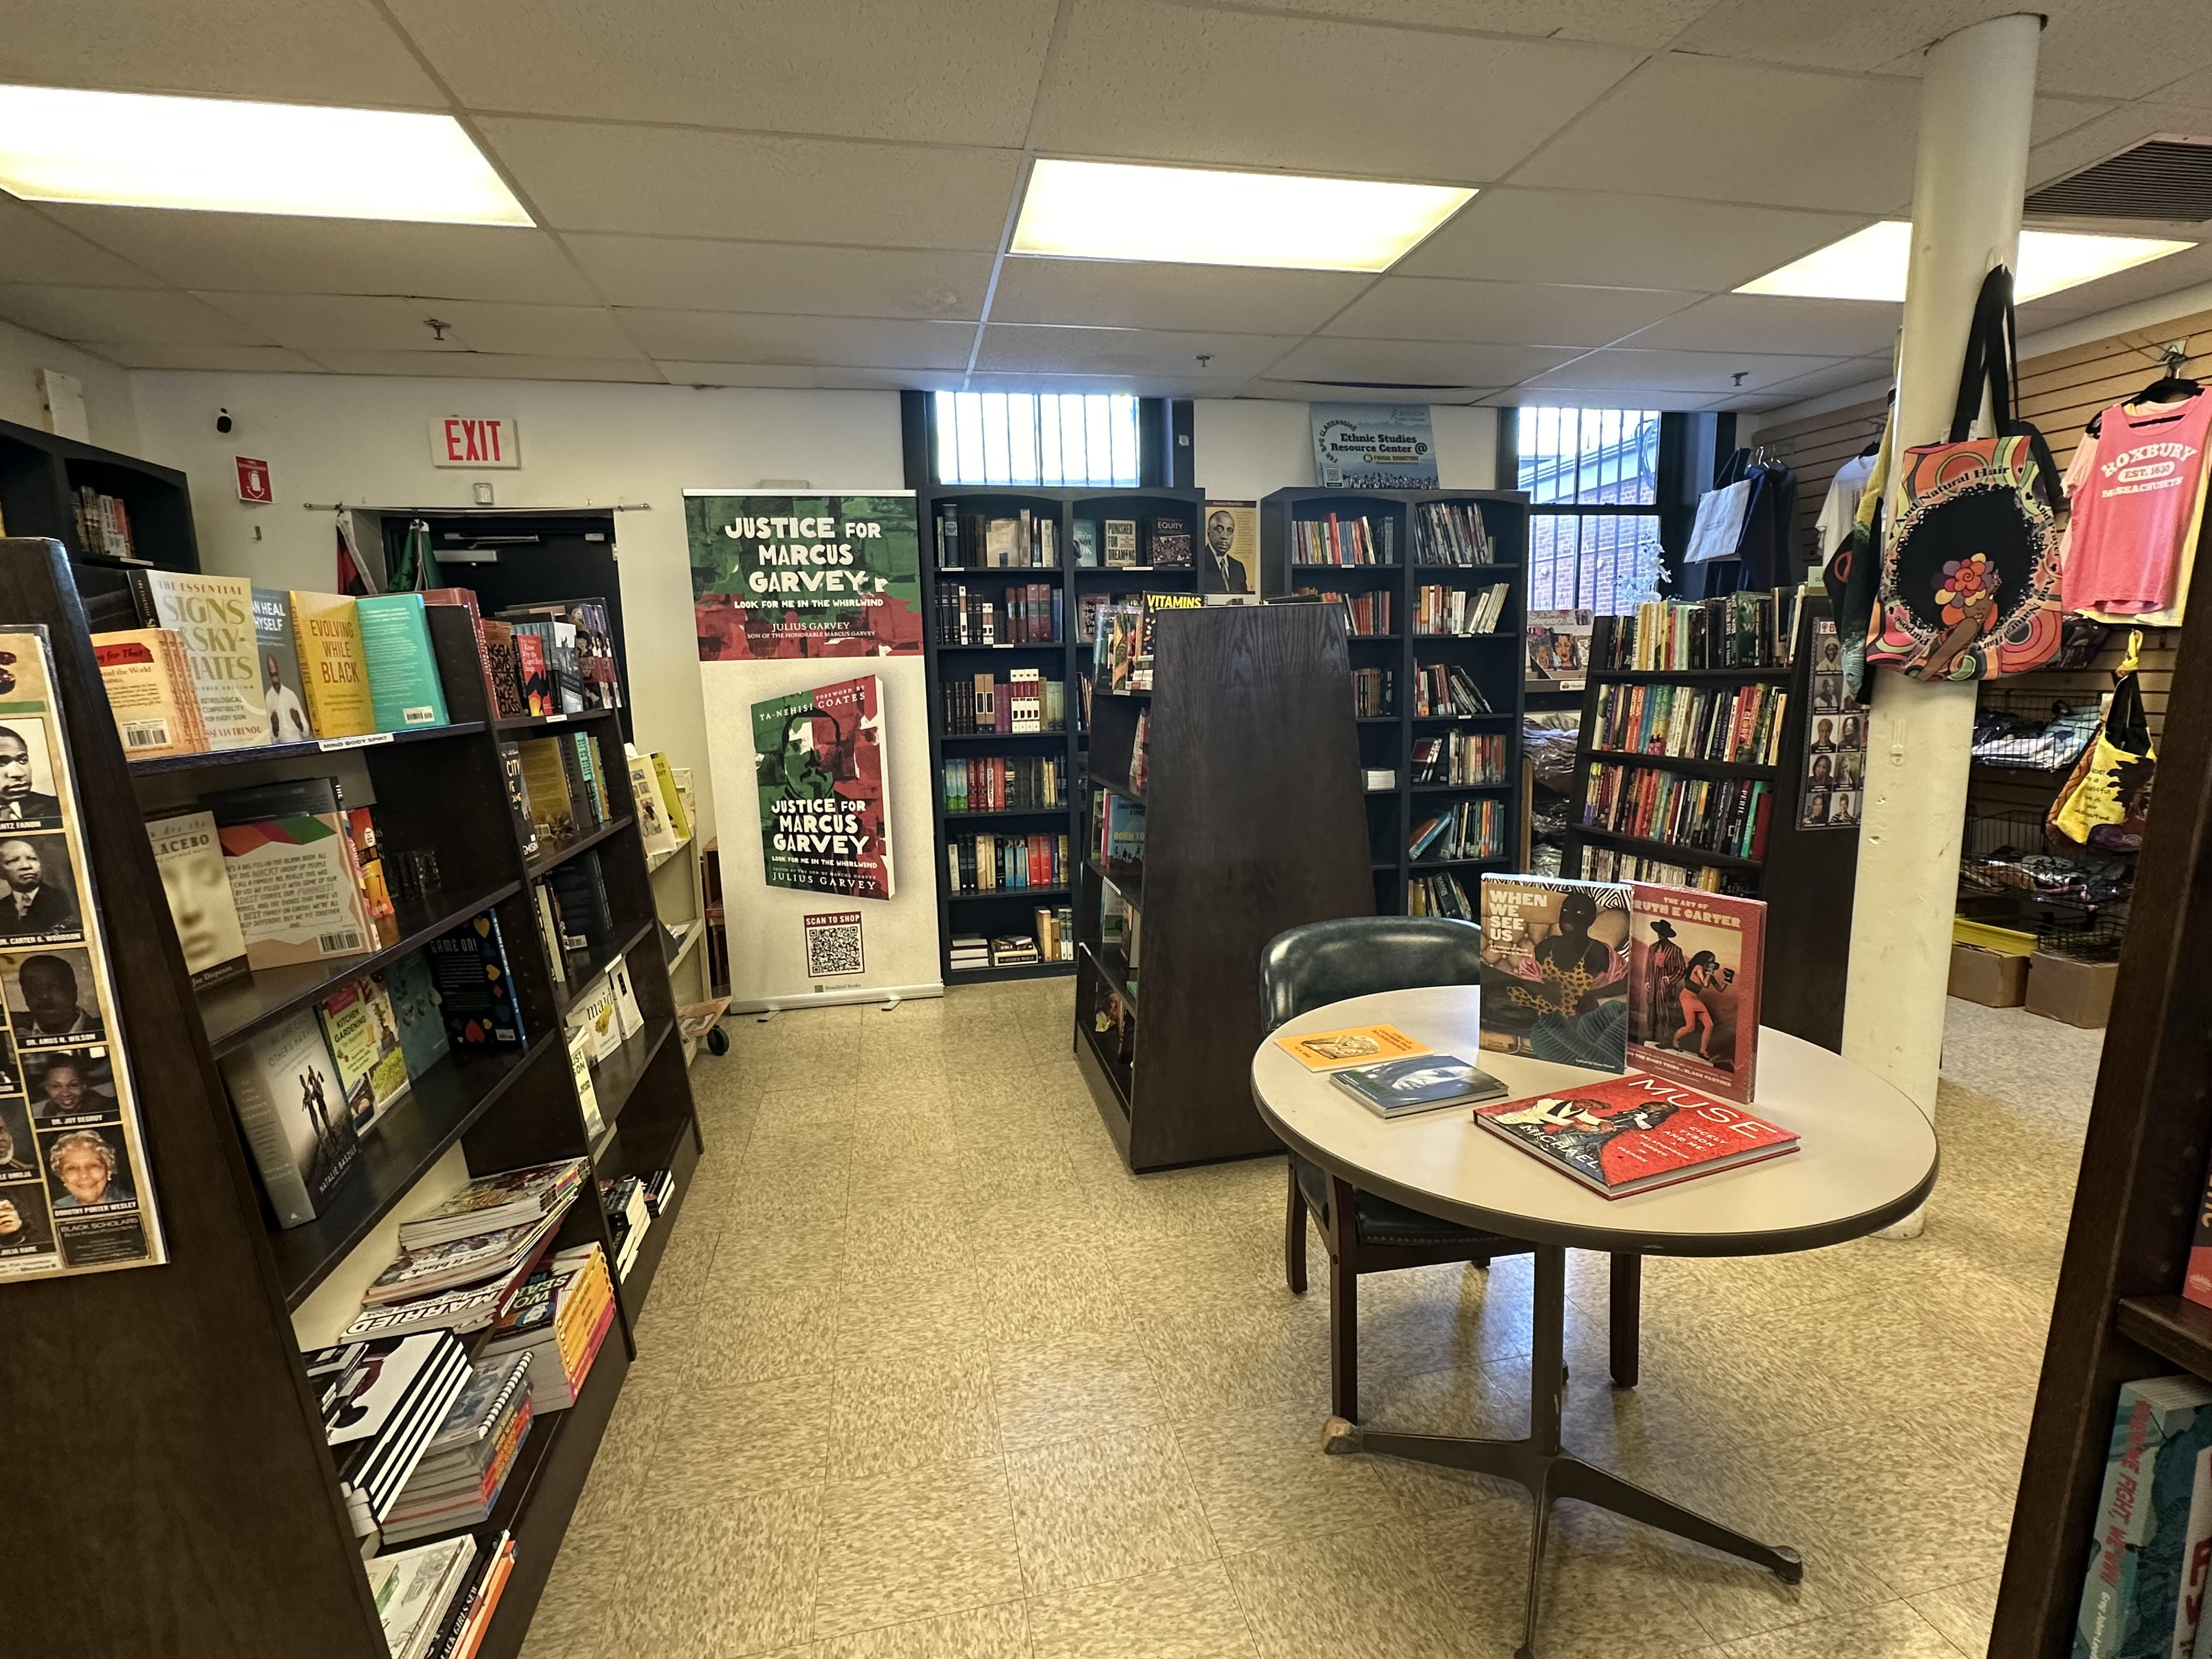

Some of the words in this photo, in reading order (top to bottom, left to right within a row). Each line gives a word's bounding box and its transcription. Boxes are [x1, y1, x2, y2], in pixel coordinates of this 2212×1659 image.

[444, 420, 501, 461] EXIT
[1340, 433, 1375, 443] Ethnic
[1378, 435, 1417, 443] Studies
[1331, 443, 1377, 453] Resource
[1379, 444, 1412, 453] Center
[1415, 442, 1427, 455] @
[2101, 442, 2199, 478] ROXBURY
[2124, 469, 2149, 478] EST.
[2151, 464, 2171, 475] 1630
[1895, 501, 1918, 528] And
[1920, 472, 1970, 507] Natural
[1974, 465, 2011, 481] Hair
[725, 517, 835, 539] JUSTICE
[845, 523, 881, 538] FOR
[1108, 523, 1133, 535] PUNISHED
[1158, 522, 1183, 531] EQUITY
[1108, 535, 1118, 548] FOR
[759, 544, 854, 566] MARCUS
[1108, 549, 1135, 561] DREAMING
[159, 580, 176, 590] THE
[180, 582, 242, 595] ESSENTIAL
[749, 571, 866, 592] GARVEY
[2036, 578, 2056, 602] And
[163, 595, 245, 624] SIGNS
[735, 600, 759, 609] LOOK
[762, 600, 778, 608] FOR
[781, 600, 794, 608] ME
[798, 600, 809, 608] IN
[811, 600, 830, 608] THE
[833, 599, 884, 607] WHIRLWIND
[1147, 595, 1201, 608] VITAMINS
[262, 603, 286, 617] HEAL
[255, 616, 284, 631] HYSELF
[310, 619, 354, 638] EVOLVING
[772, 623, 806, 633] JULIUS
[809, 622, 850, 630] GARVEY
[1894, 615, 1930, 646] Purpose
[198, 627, 246, 652] SKY-
[107, 650, 120, 659] for
[322, 641, 351, 657] WHILE
[320, 662, 360, 684] BLACK
[816, 687, 854, 701] FOREWORD
[202, 706, 245, 714] COMPATIBILITY
[759, 704, 814, 721] TA-NEHISI
[817, 692, 866, 710] COATES
[233, 725, 263, 736] TRENOU
[506, 759, 521, 777] CITY
[771, 798, 836, 814] JUSTICE
[840, 800, 866, 812] FOR
[779, 814, 859, 834] MARCUS
[1114, 832, 1135, 840] BORN
[774, 834, 869, 855] GARVEY
[836, 860, 878, 869] WHIRLWIND
[772, 872, 814, 884] JULIUS
[820, 876, 876, 890] GARVEY
[1489, 890, 1548, 907] WHEN
[1663, 897, 1679, 905] THE
[1680, 900, 1696, 908] ART
[244, 911, 261, 920] BEST
[316, 908, 340, 917] TOGETHER
[1489, 903, 1519, 917] WE
[1634, 900, 1669, 915] RUTH
[1672, 907, 1681, 917] E
[1684, 909, 1741, 928] CARTER
[805, 917, 827, 926] SCAN
[828, 916, 839, 924] TO
[839, 915, 860, 924] SHOP
[1490, 916, 1524, 930] SEE
[10, 935, 35, 944] CARTER
[36, 935, 44, 943] G.
[46, 933, 81, 943] WOODSON
[1490, 928, 1513, 942] US
[430, 938, 459, 953] GAME
[461, 938, 478, 951] ON!
[586, 987, 614, 1020] maid
[336, 1007, 360, 1029] KITCHEN
[334, 1015, 366, 1043] GARDENING
[67, 1033, 96, 1042] WILSON
[1684, 1068, 1704, 1079] BLACK
[1704, 1074, 1731, 1087] PANTHER
[1628, 1078, 1778, 1140] MUSE
[1662, 1130, 1688, 1144] AND
[1679, 1129, 1716, 1148] TYSON
[1689, 1125, 1728, 1144] CICELY
[1520, 1125, 1599, 1170] MICHAEL
[1617, 1146, 1648, 1163] FASHION
[1639, 1133, 1690, 1160] RELATIONSHIP
[1639, 1141, 1668, 1158] FORGED
[319, 1168, 339, 1194] NATALIE
[338, 1143, 357, 1173] BASZILE
[110, 1202, 137, 1211] WESLEY
[61, 1224, 90, 1233] BLACK
[91, 1218, 139, 1229] SCHOLARS
[411, 1262, 450, 1275] black
[347, 1290, 498, 1335] MARRIED
[365, 1307, 395, 1318] Book
[396, 1297, 445, 1312] Coloring
[2126, 1400, 2152, 1447] WHEN
[2121, 1446, 2141, 1475] WE
[2108, 1473, 2137, 1525] FIGHT,
[2107, 1525, 2126, 1553] WE
[2101, 1592, 2111, 1607] Greg
[453, 1605, 469, 1635] GIRLS
[466, 1583, 478, 1606] SEW
